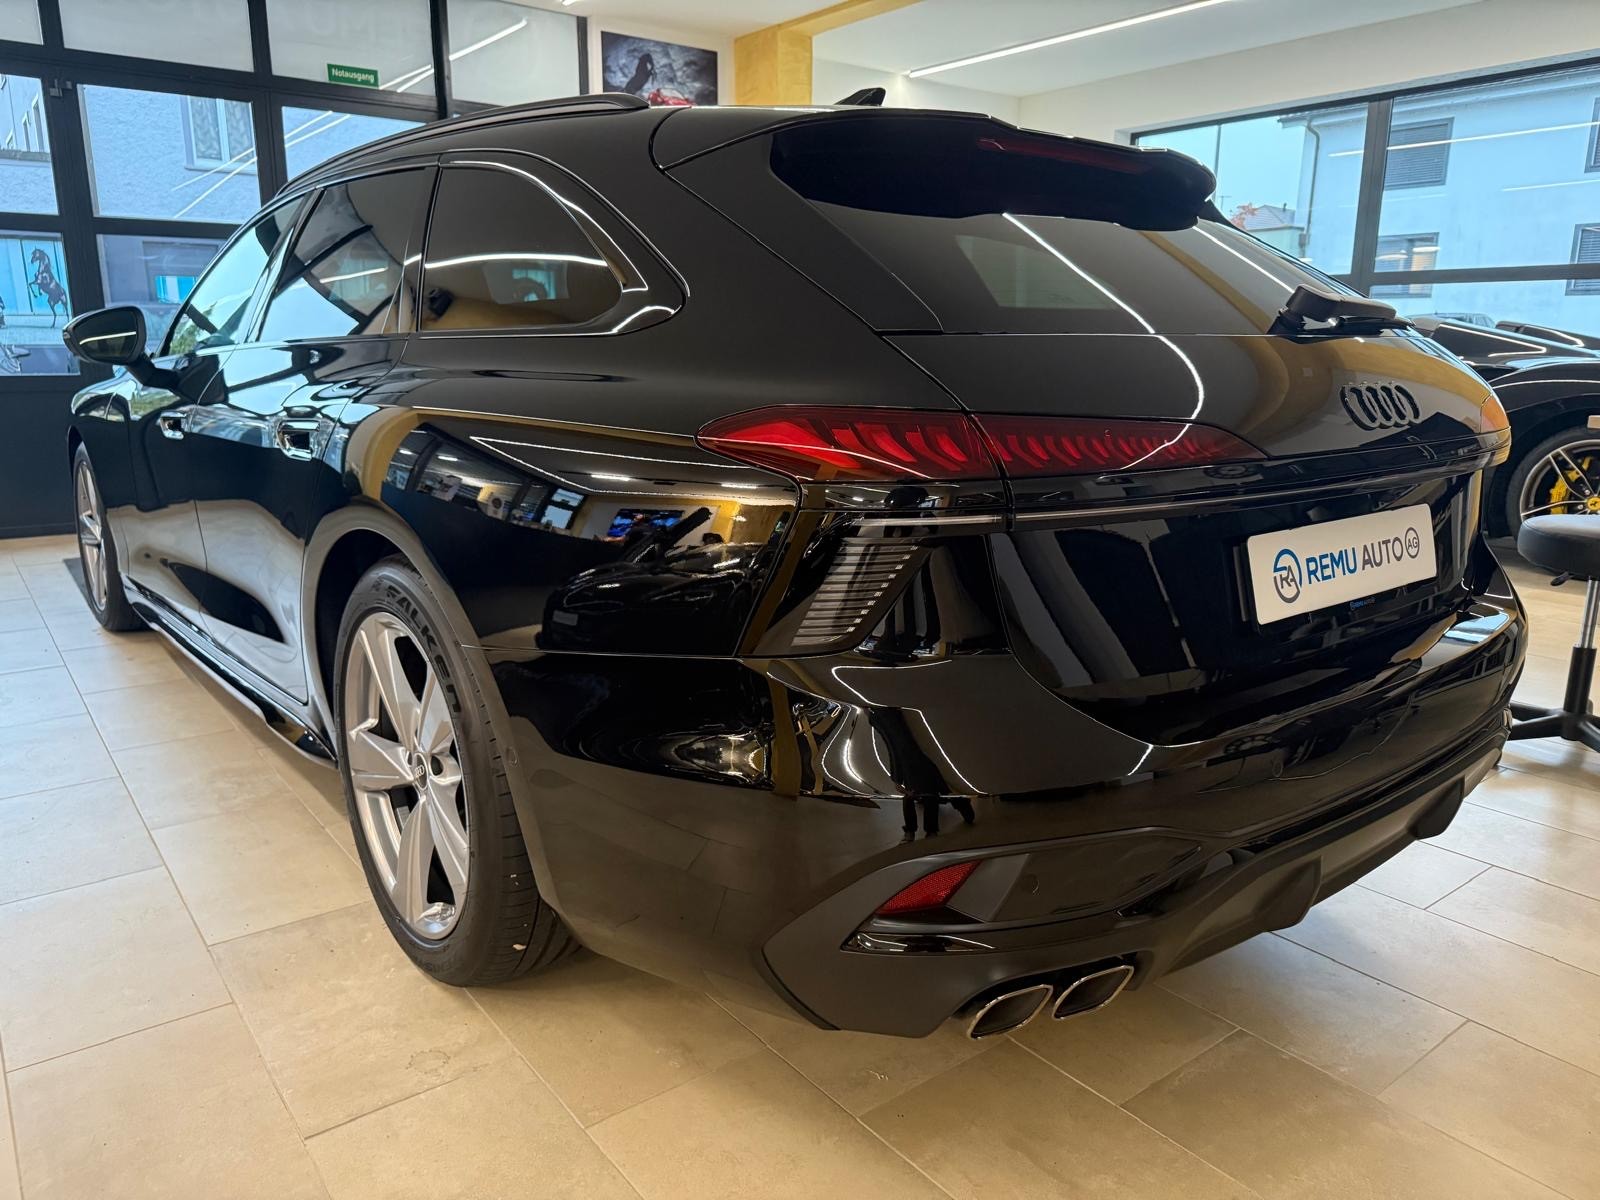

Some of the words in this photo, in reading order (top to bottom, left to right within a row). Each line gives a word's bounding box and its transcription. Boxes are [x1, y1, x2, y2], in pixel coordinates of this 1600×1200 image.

[331, 67, 375, 84] Notausgang
[1305, 547, 1358, 585] REMU
[1361, 536, 1404, 571] AUTO
